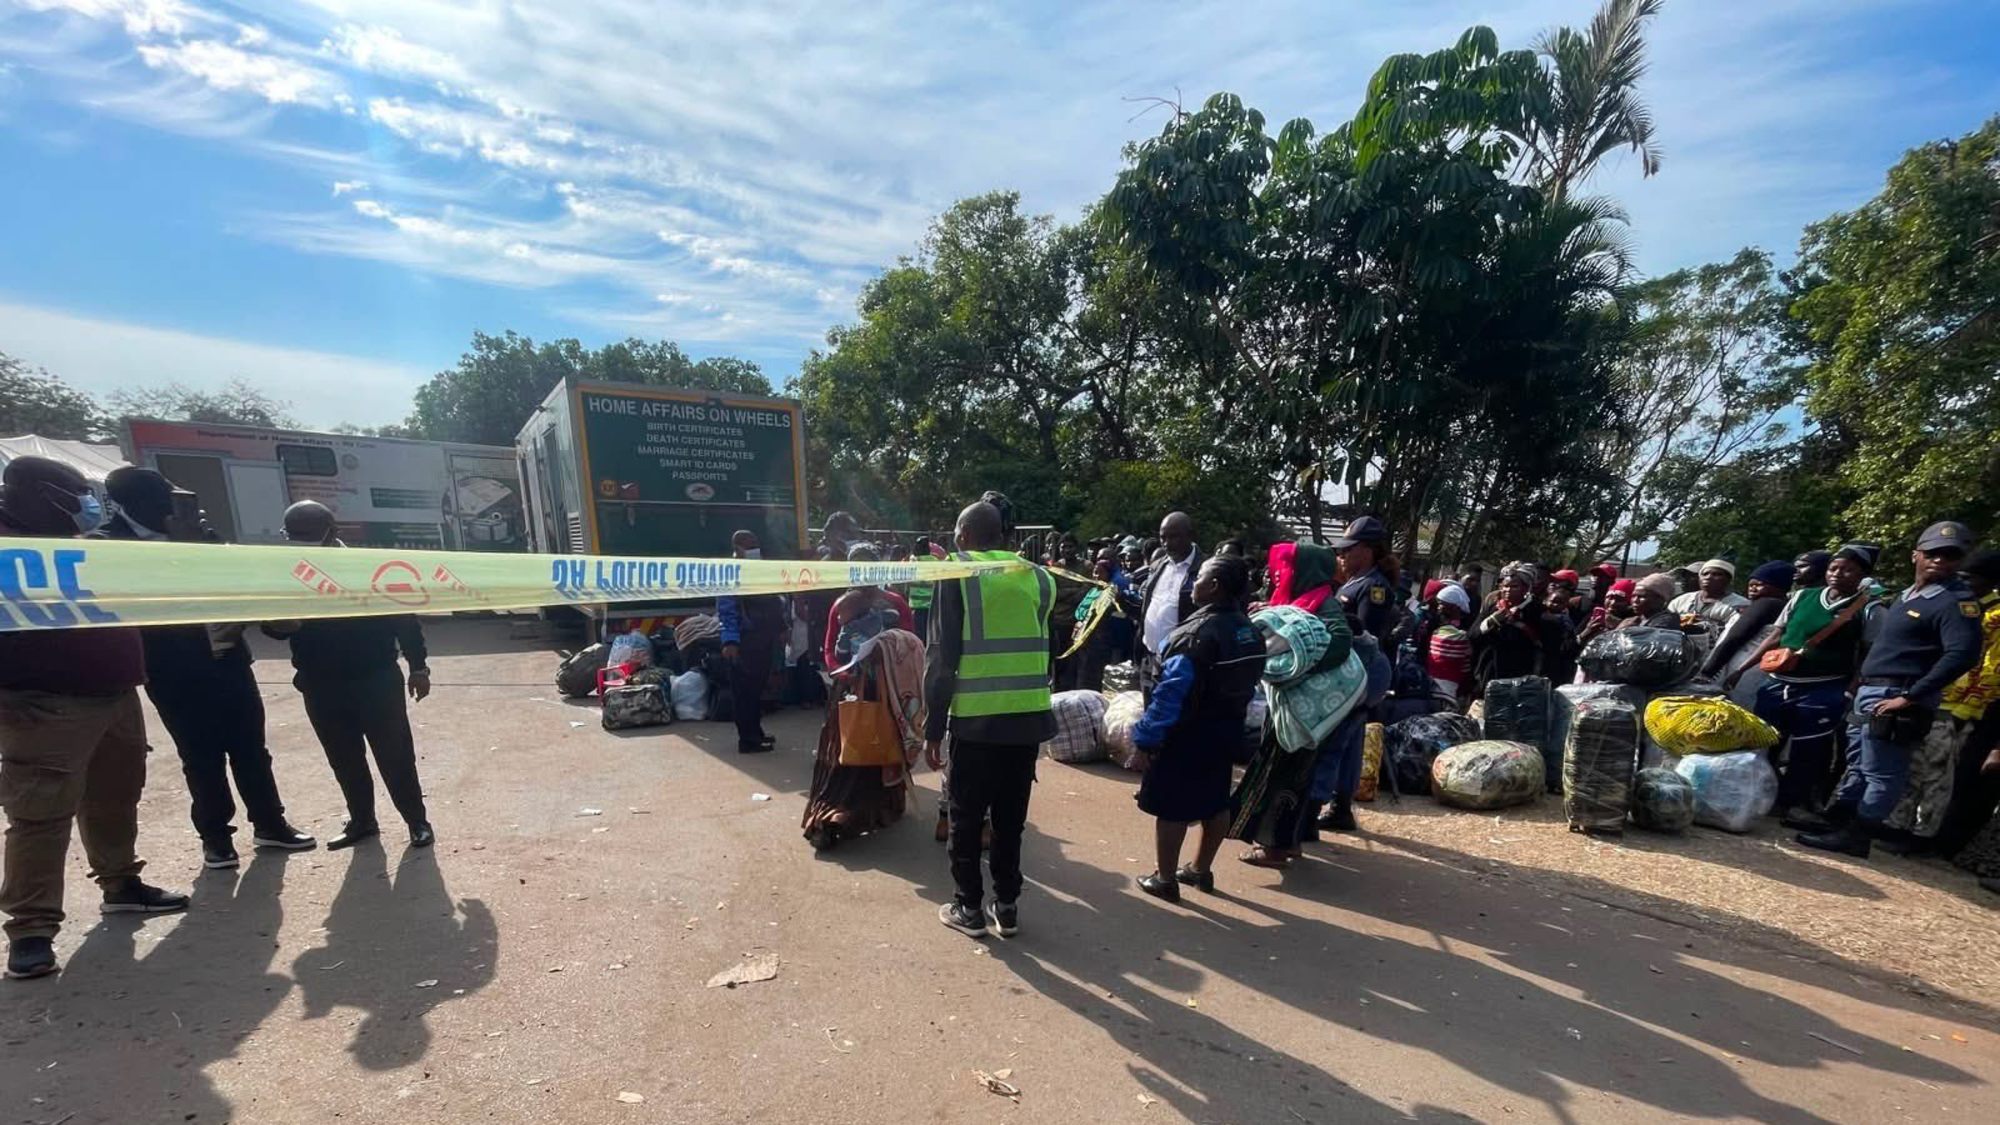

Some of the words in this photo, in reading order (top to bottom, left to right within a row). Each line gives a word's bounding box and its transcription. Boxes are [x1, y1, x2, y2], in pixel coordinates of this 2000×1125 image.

[589, 398, 637, 416] HOME
[641, 402, 705, 421] AFFAIRS
[709, 408, 730, 423] ON
[735, 409, 791, 428] WHEELS
[647, 422, 676, 432] BIRTH
[678, 424, 743, 437] CERTIFICATES
[646, 433, 679, 444] DEATH
[681, 436, 745, 449] CERTIFICATES
[638, 445, 689, 457] MARRIAGE
[690, 448, 755, 461] CERTIFICATES
[659, 459, 692, 469] SMART
[694, 460, 704, 469] ID
[706, 461, 737, 471] CARDS
[672, 471, 728, 481] PASSPORTS
